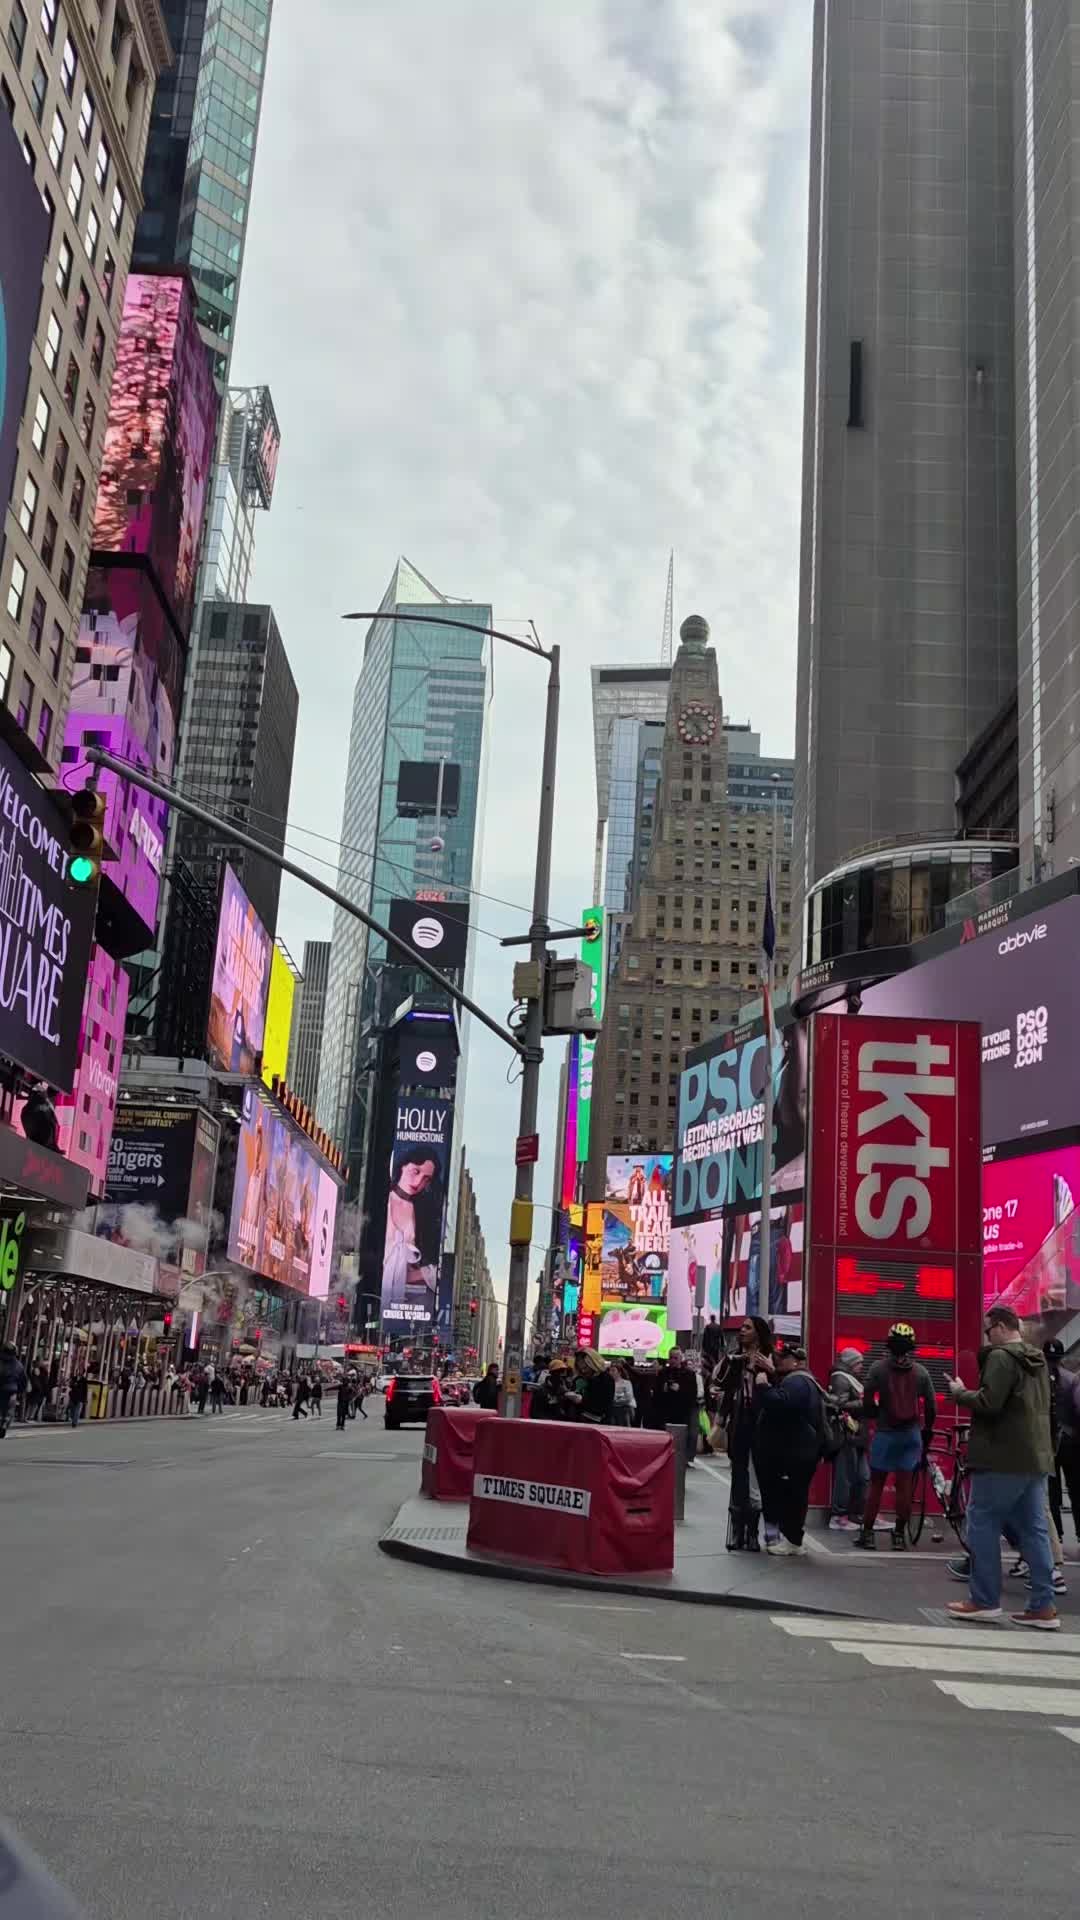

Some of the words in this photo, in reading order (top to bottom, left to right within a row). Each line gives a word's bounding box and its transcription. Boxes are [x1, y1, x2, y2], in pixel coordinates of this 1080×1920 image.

[20, 873, 71, 966] TIMES
[978, 900, 1013, 923] MARRIOTT
[978, 913, 1009, 933] MARQUIS
[998, 924, 1048, 955] abbvie
[0, 922, 63, 1046] UARE.
[1017, 1006, 1048, 1035] PSO
[1017, 1026, 1048, 1052] DONE
[841, 1048, 850, 1086] service
[1014, 1045, 1043, 1069] .COM
[396, 1107, 447, 1132] HOLLY
[396, 1131, 445, 1144] HUMBERSTONE
[683, 1120, 717, 1147] LETTING
[854, 1034, 956, 1240] tkts
[682, 1140, 711, 1164] DECIDE
[711, 1133, 736, 1153] WHAT
[140, 1174, 157, 1185] york
[839, 1140, 849, 1209] development
[642, 1189, 668, 1206] ALL
[1004, 1199, 1019, 1218] 17
[635, 1221, 671, 1236] LEAD
[838, 1211, 849, 1237] fund
[635, 1236, 670, 1252] HERE
[383, 1309, 404, 1320] CRUEL
[404, 1310, 431, 1322] WORLD
[483, 1477, 525, 1499] TIMES
[529, 1484, 584, 1510] SQUARE
